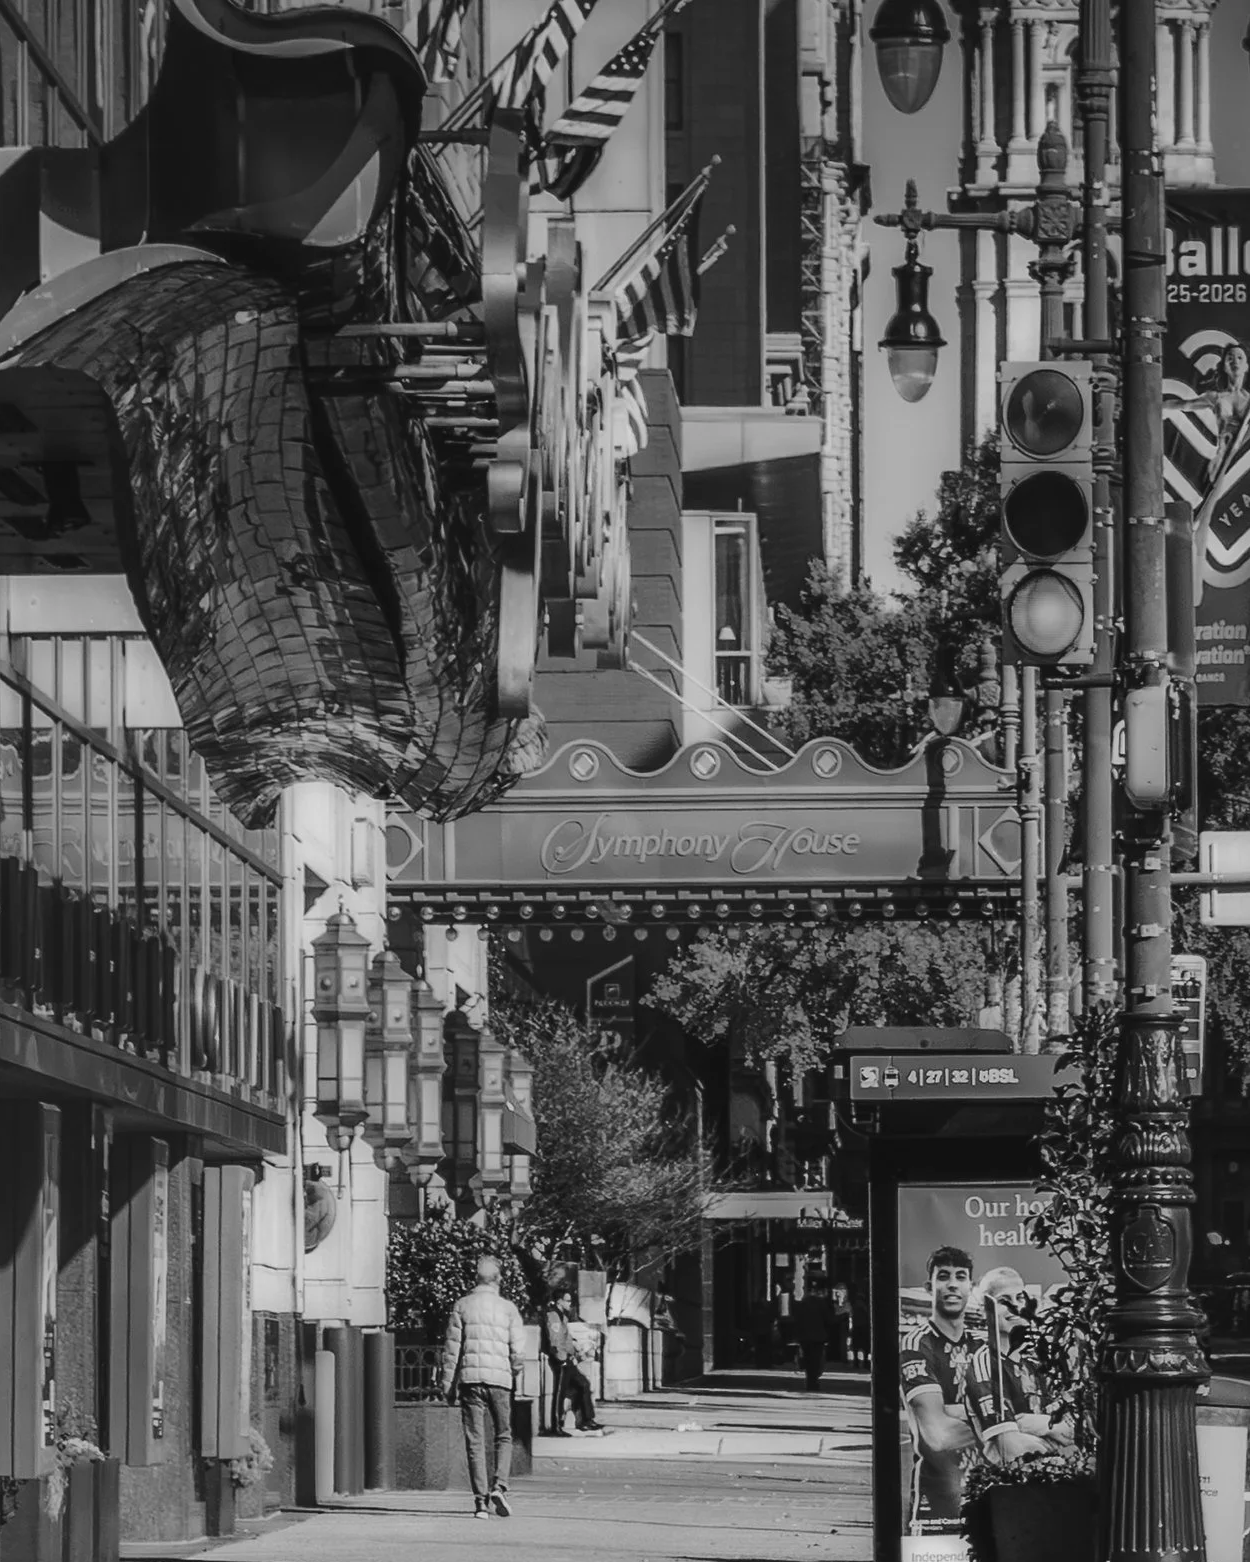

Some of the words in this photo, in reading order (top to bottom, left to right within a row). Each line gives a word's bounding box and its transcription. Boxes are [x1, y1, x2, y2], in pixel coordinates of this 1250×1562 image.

[1165, 226, 1250, 277] all
[540, 812, 731, 875] Symphony
[730, 820, 861, 875] House
[925, 1069, 943, 1084] 27
[951, 1069, 969, 1084] 32
[964, 1196, 1010, 1218] Our
[978, 1223, 1043, 1247] healt
